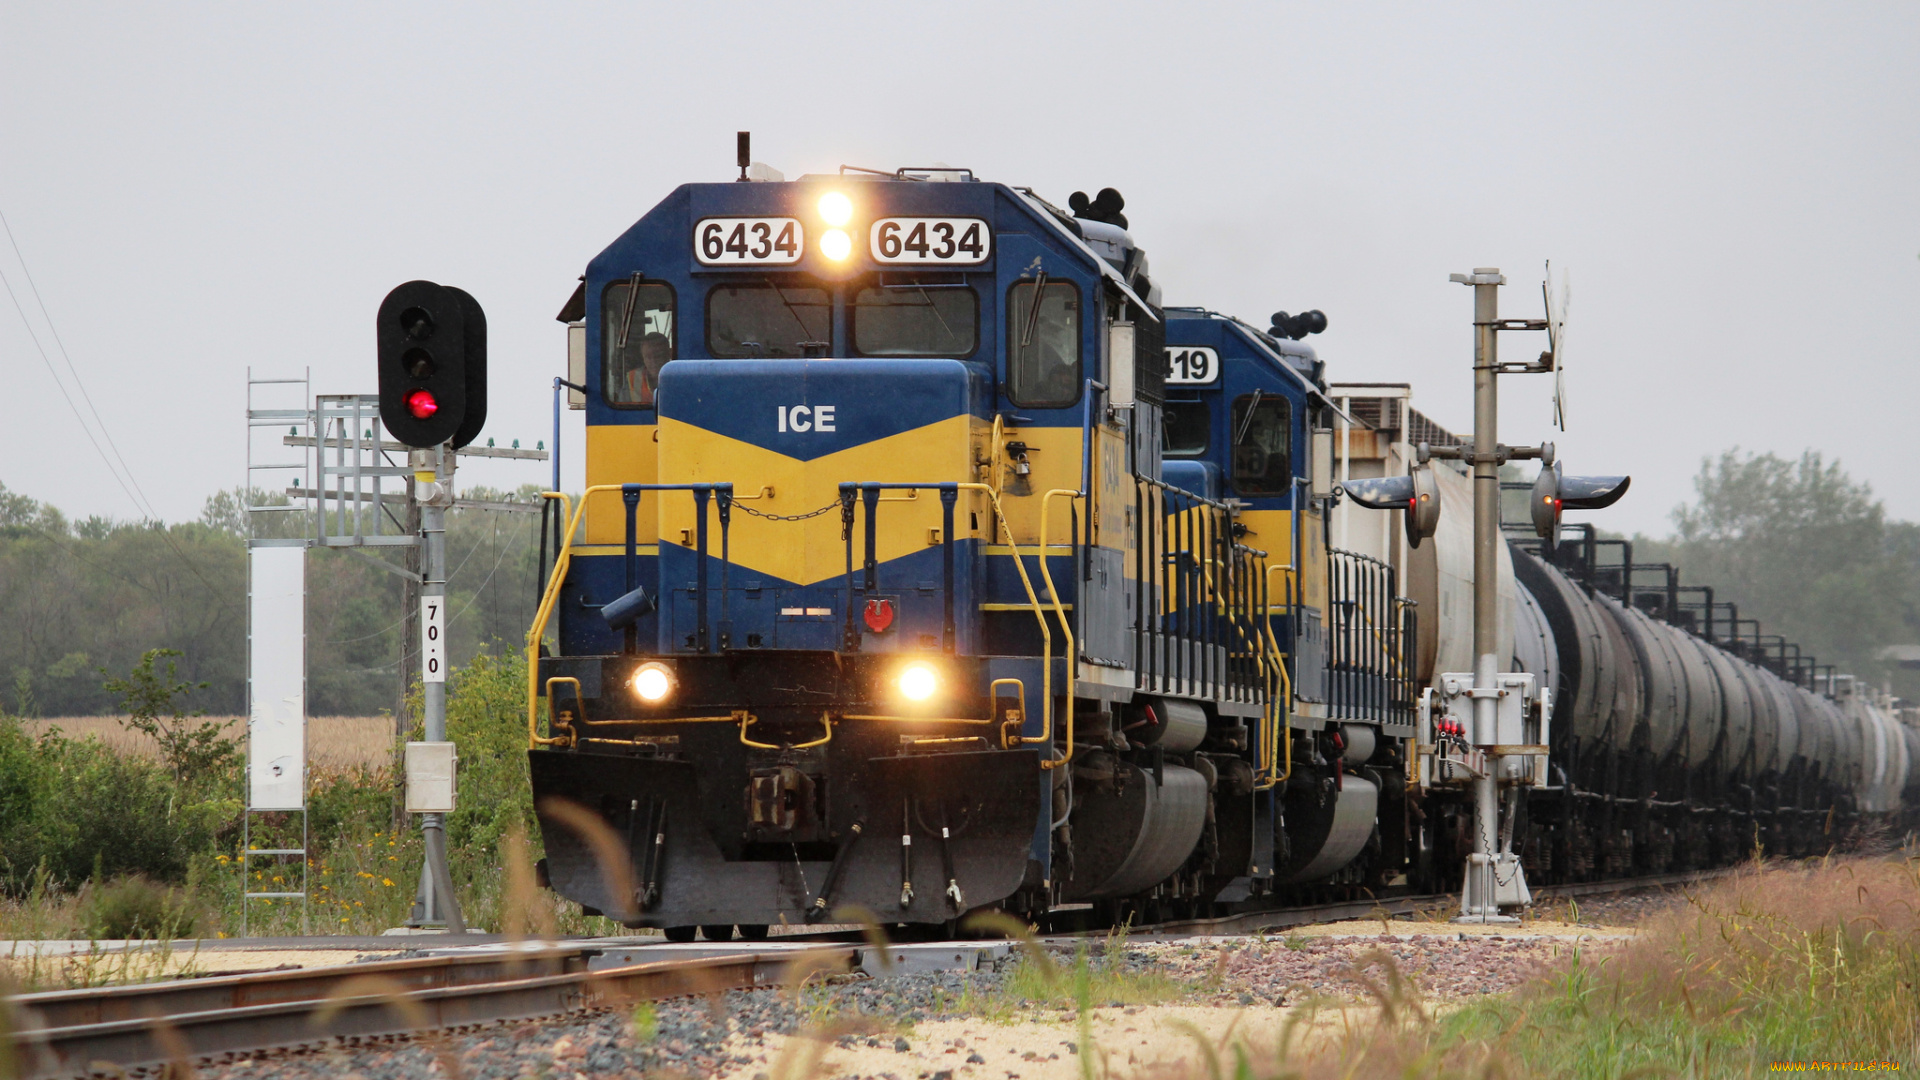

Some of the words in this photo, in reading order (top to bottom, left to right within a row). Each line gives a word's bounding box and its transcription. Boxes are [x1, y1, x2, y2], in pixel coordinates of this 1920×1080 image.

[702, 221, 798, 259] 6434
[877, 221, 984, 259] 6434
[778, 405, 836, 433] ICE
